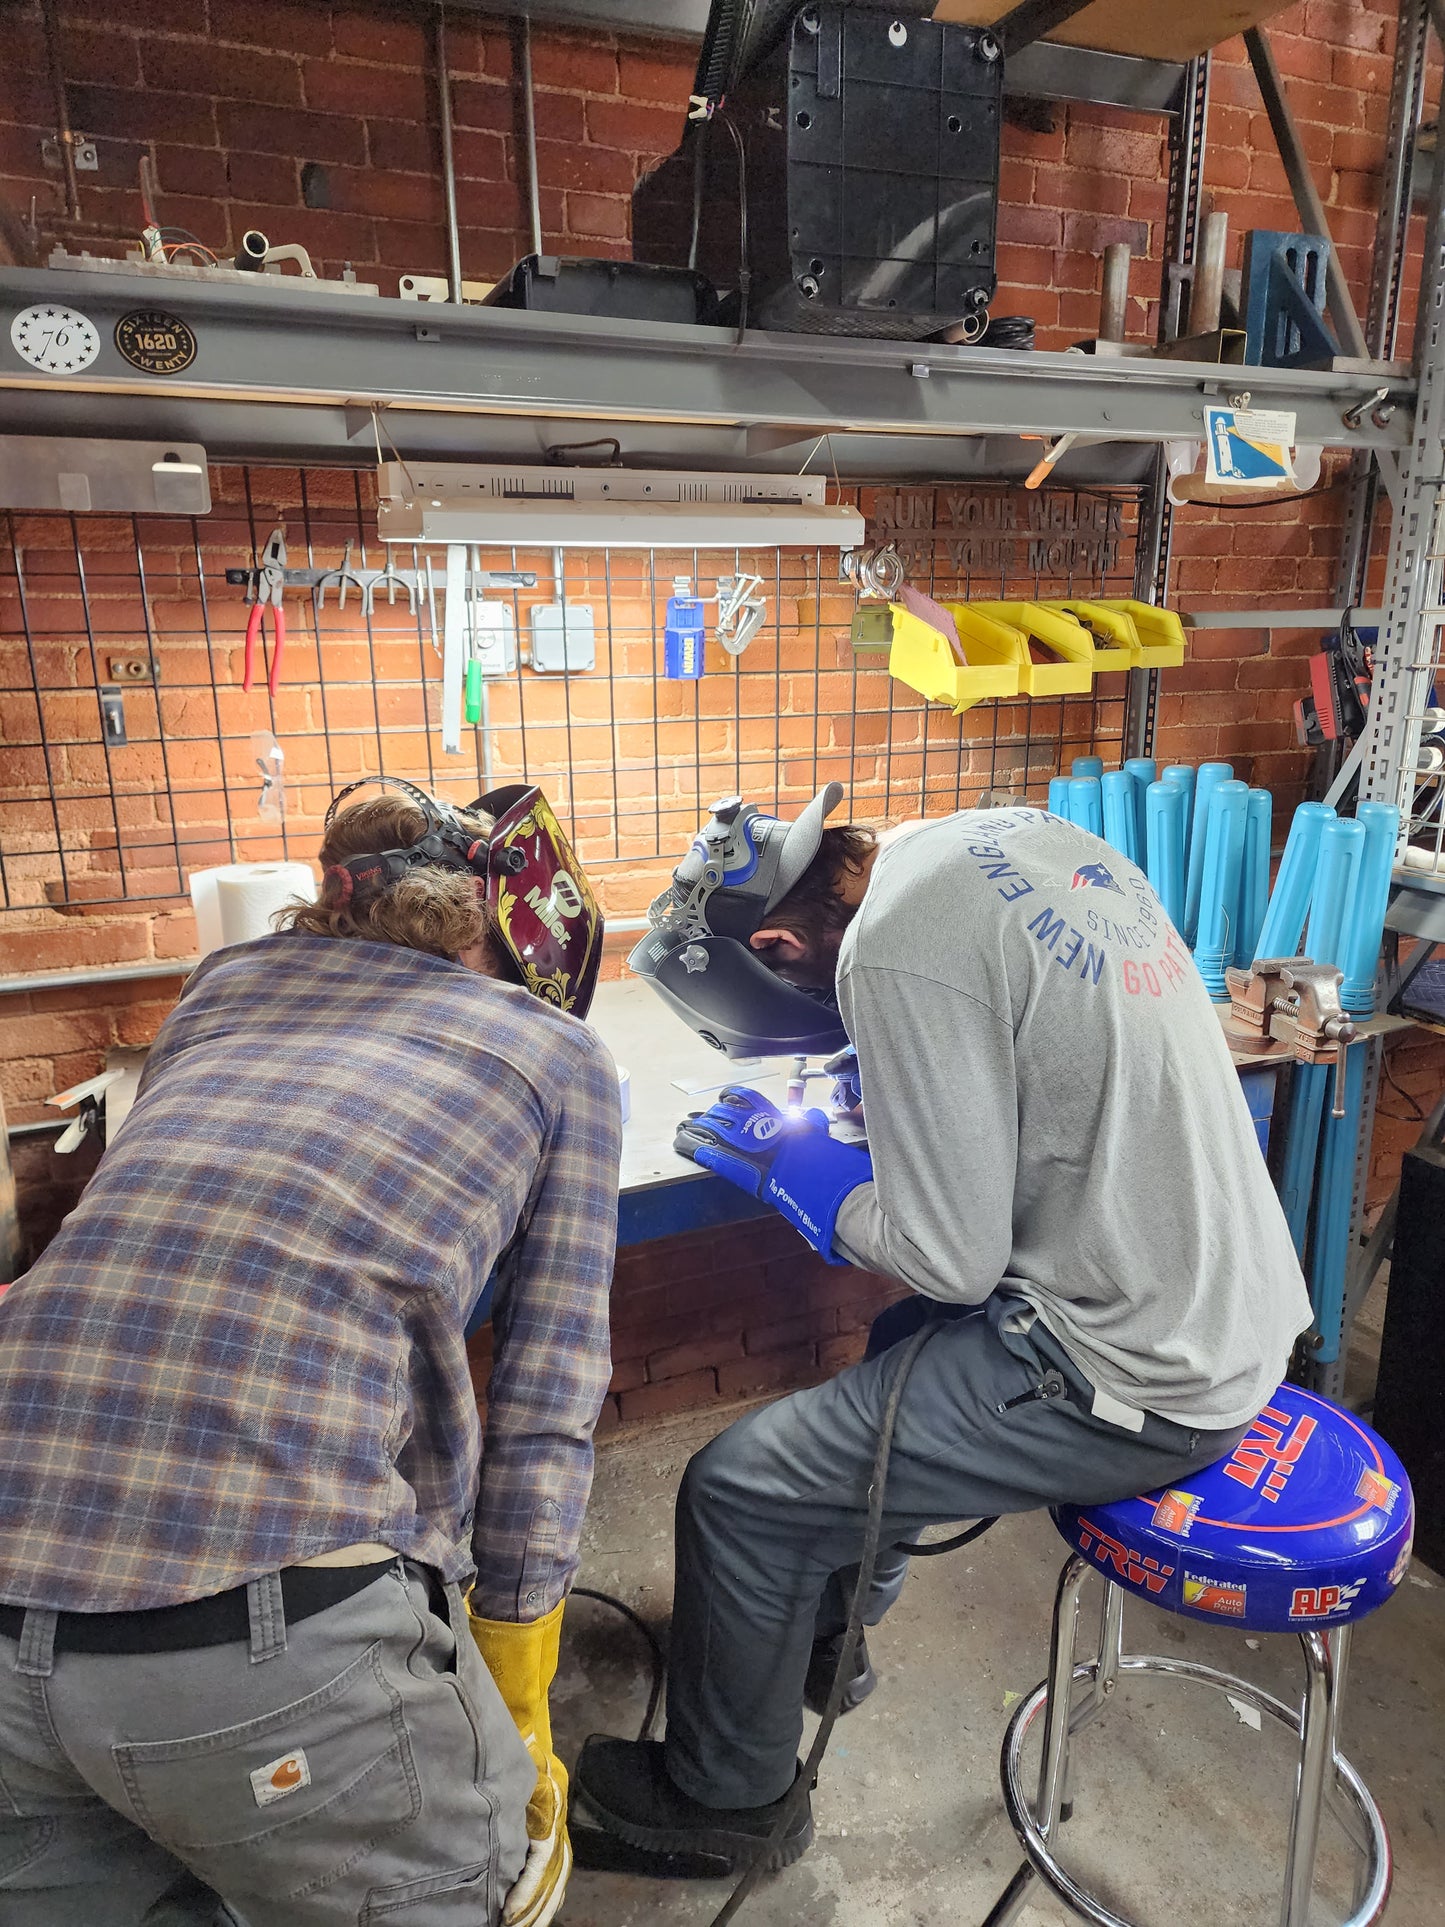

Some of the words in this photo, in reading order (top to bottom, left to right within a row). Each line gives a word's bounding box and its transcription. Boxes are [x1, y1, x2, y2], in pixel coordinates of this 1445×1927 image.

[41, 325, 74, 357] 76
[123, 313, 183, 334] SIXTEEN
[134, 333, 177, 350] 1620
[131, 350, 188, 370] TWENTY
[875, 495, 934, 529] RUN
[947, 496, 1017, 529] YOUR
[1028, 497, 1122, 531] WELDER
[946, 538, 1017, 572] YOUR
[1028, 538, 1119, 574] MOUTH
[683, 637, 694, 674] IRWIN
[962, 818, 1035, 902] ENGLAND
[1087, 909, 1151, 949] SINCE
[1129, 876, 1158, 939] 1960
[1027, 907, 1105, 986] NEW
[1122, 958, 1162, 998] GO
[768, 1177, 778, 1194] The
[776, 1187, 799, 1212] Power
[797, 1207, 804, 1219] of
[1223, 1404, 1319, 1504] TRW
[1163, 1506, 1177, 1528] Auto
[1181, 1496, 1205, 1538] Federated
[1077, 1516, 1175, 1594] TRW
[1184, 1570, 1247, 1591] Federated
[1213, 1602, 1243, 1614] Parts
[1217, 1596, 1243, 1607] Auto
[1289, 1585, 1341, 1617] AP
